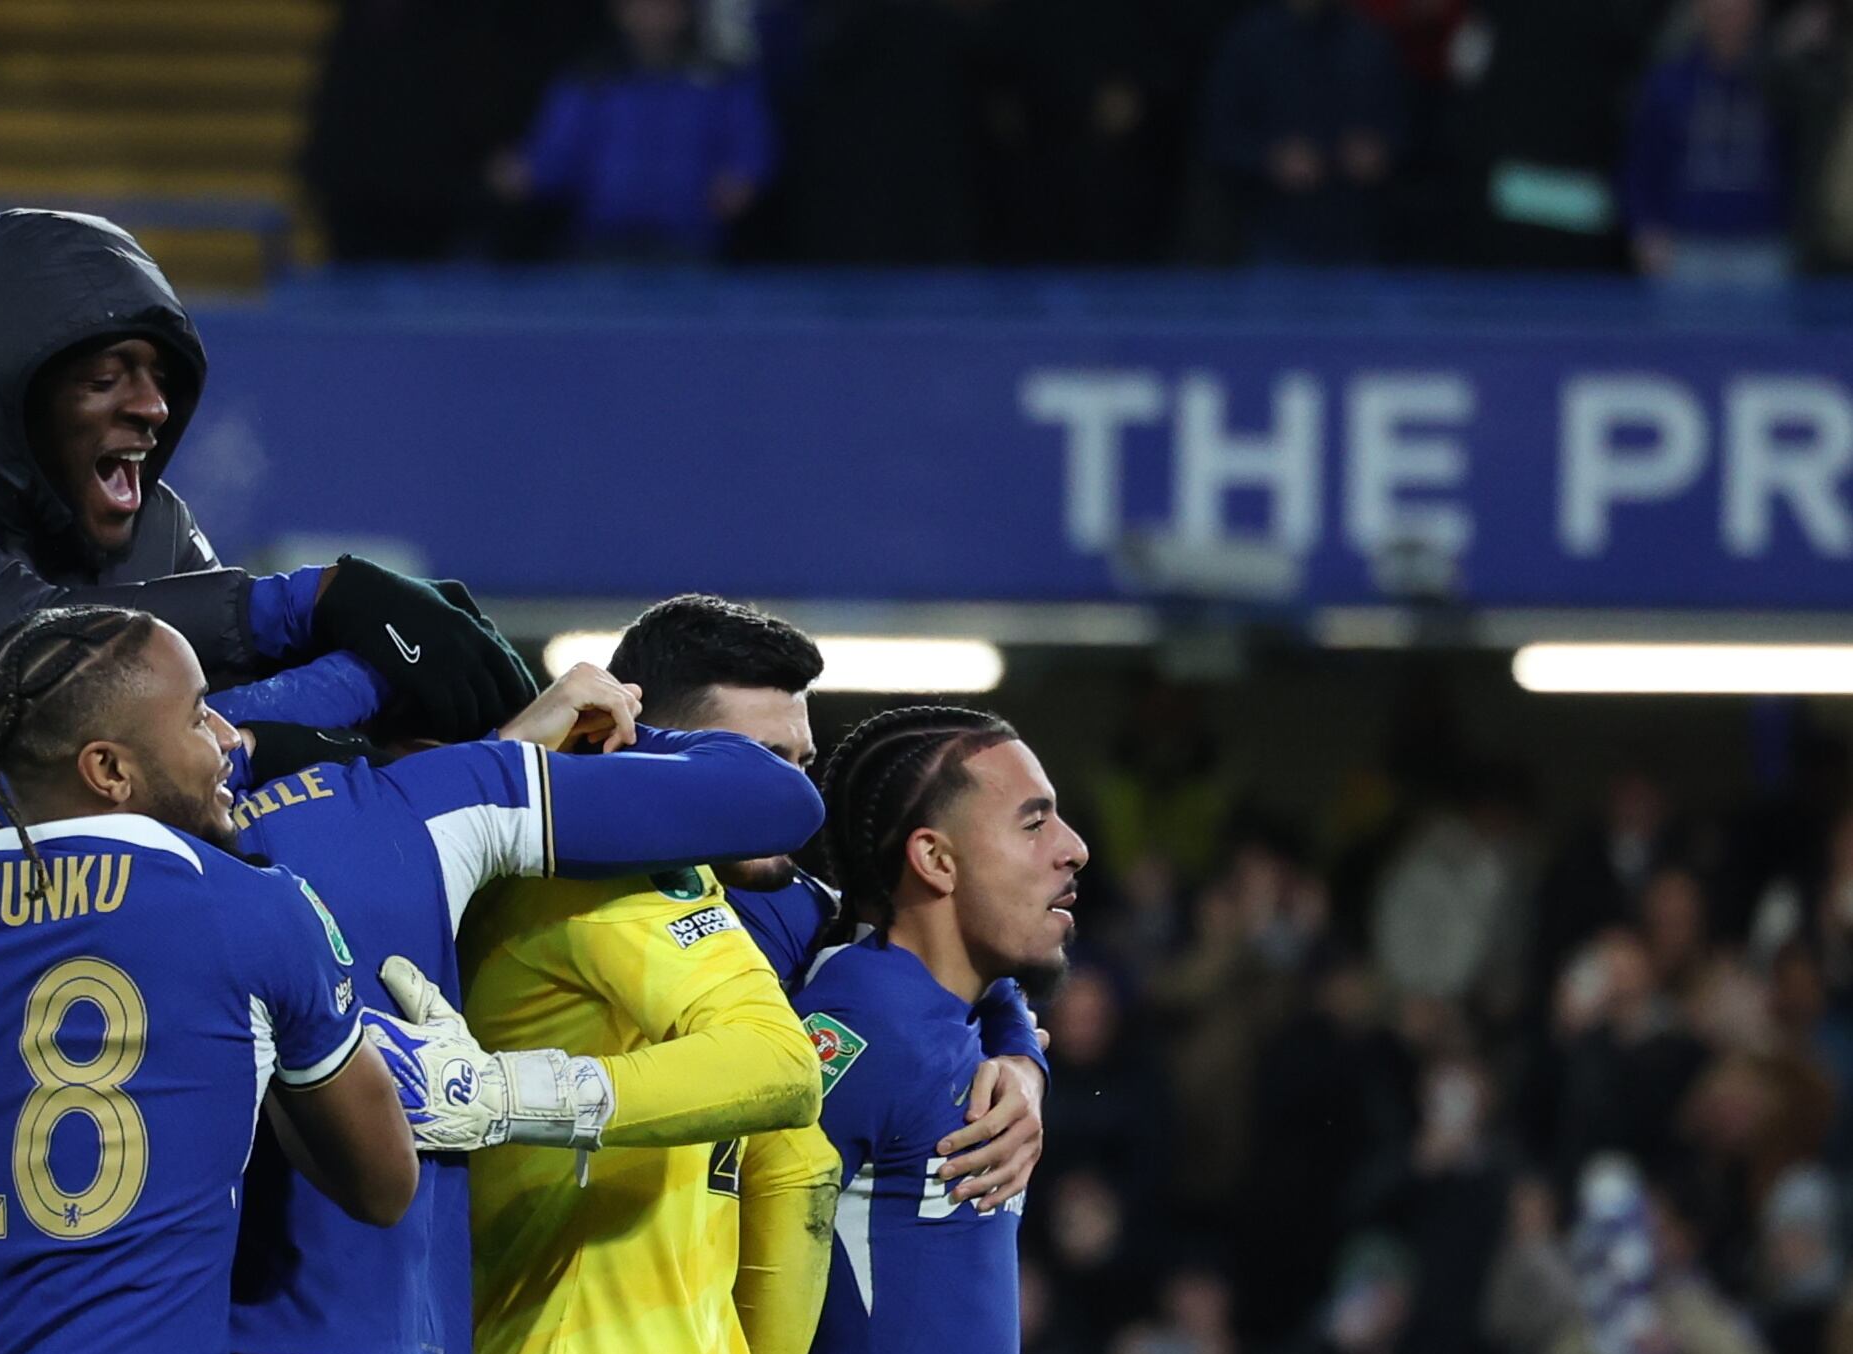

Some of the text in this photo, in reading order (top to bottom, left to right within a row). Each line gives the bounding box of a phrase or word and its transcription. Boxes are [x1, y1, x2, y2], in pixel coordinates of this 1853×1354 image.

[1018, 368, 1853, 558] THE PR
[233, 766, 335, 831] HILE
[667, 919, 694, 935] No
